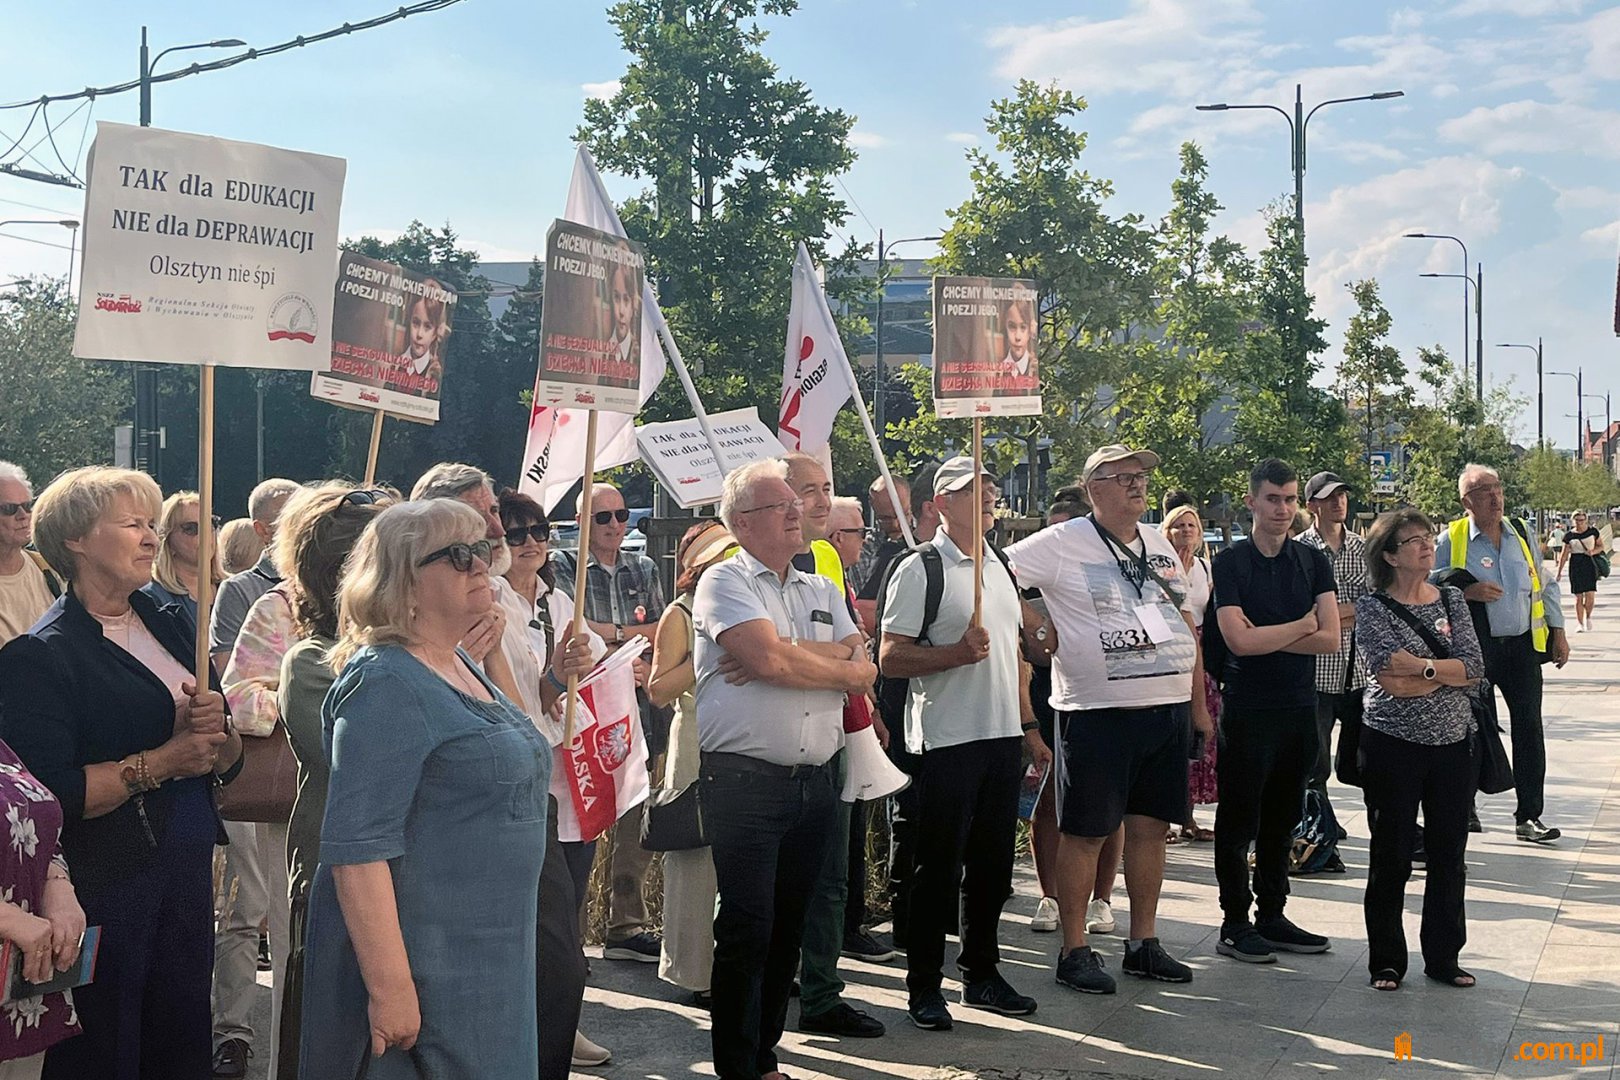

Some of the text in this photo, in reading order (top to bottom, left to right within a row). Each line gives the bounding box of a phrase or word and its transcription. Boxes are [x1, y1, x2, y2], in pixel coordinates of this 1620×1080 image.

[119, 165, 315, 215] TAK dla EDUKACJI
[112, 209, 314, 254] NIE dla DEPRAWACJI
[557, 232, 591, 255] CHCEMY
[150, 255, 275, 289] Olsztyn nie śpi
[346, 263, 389, 286] CHCEMY
[553, 255, 558, 270] I
[560, 256, 586, 276] POEZJI
[340, 281, 346, 292] I
[346, 281, 379, 301] POEZJI
[943, 285, 981, 299] CHCEMY
[942, 303, 946, 315] I
[947, 304, 977, 316] POEZJI
[332, 357, 374, 379] ZIECKA
[650, 433, 676, 445] TAK
[679, 429, 697, 441] dla
[660, 447, 681, 458] NIE
[681, 443, 698, 455] dla
[571, 733, 598, 813] OLSKA
